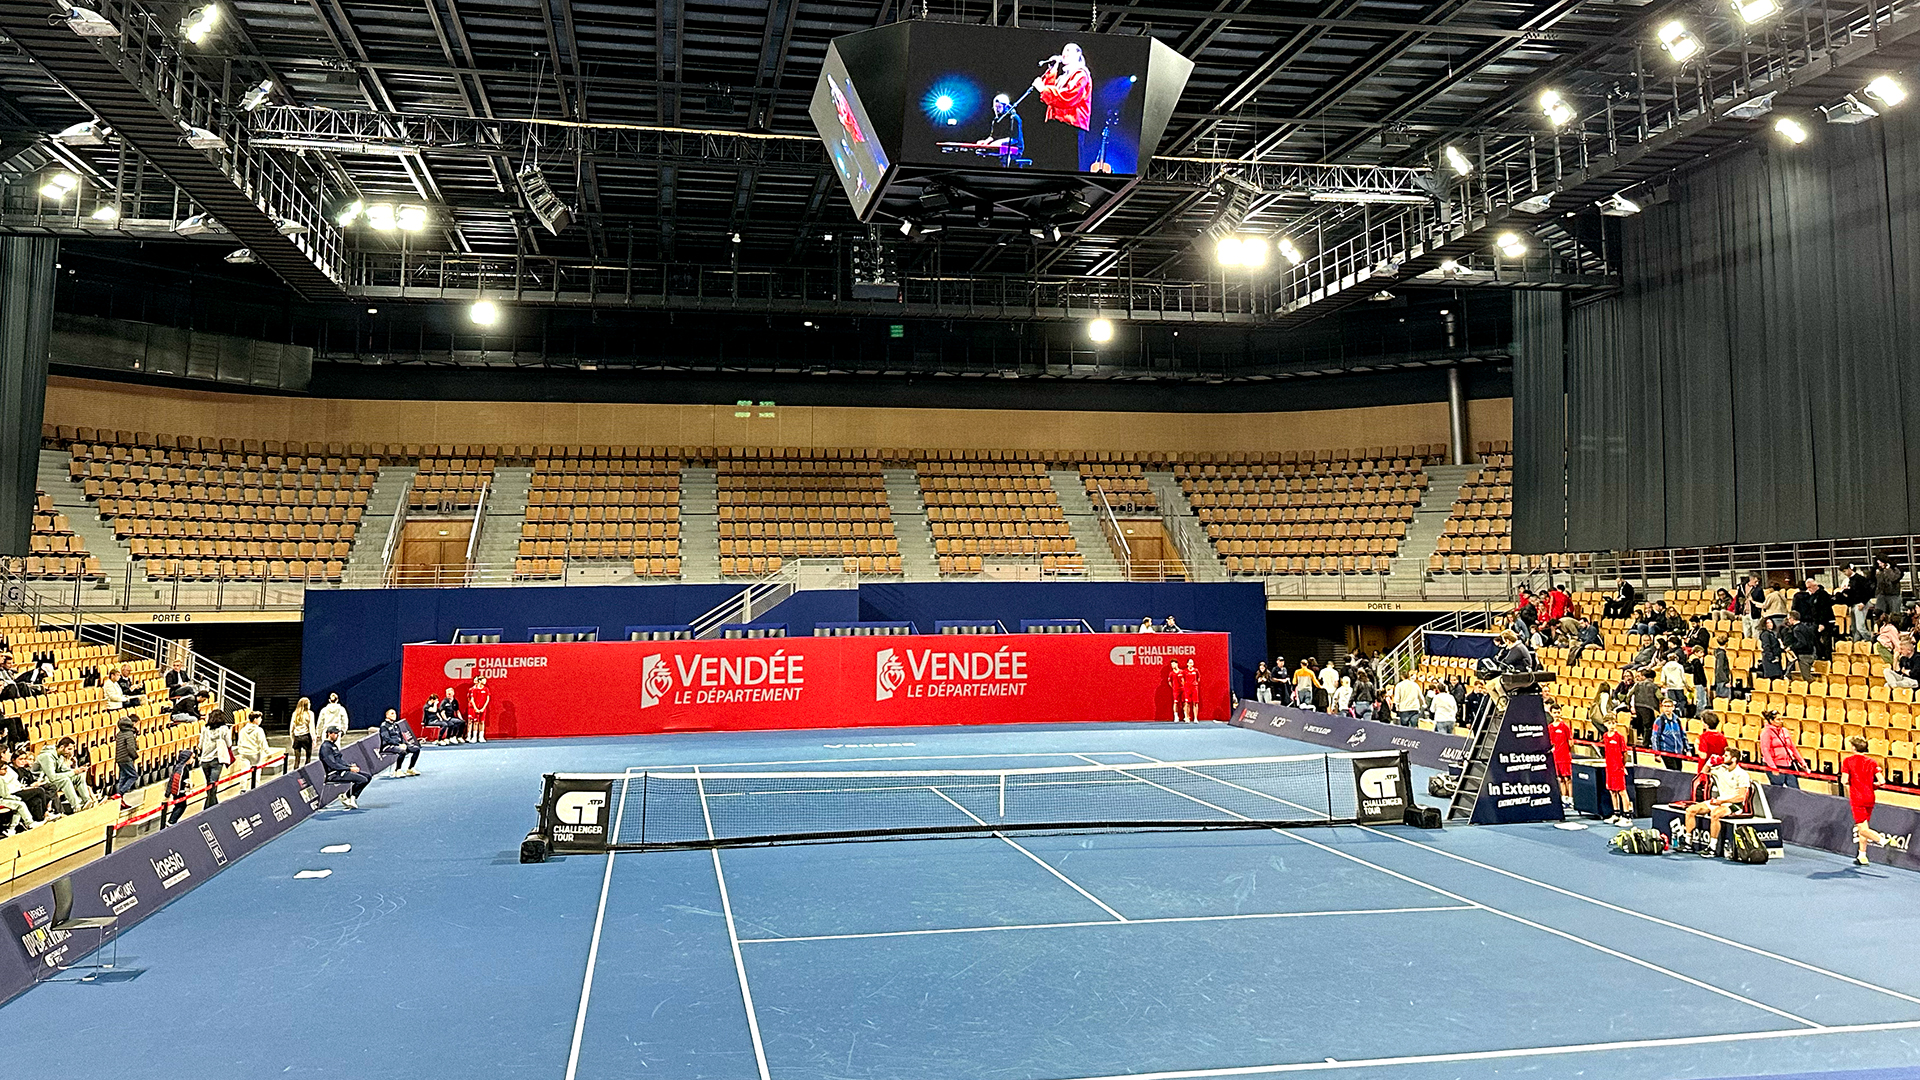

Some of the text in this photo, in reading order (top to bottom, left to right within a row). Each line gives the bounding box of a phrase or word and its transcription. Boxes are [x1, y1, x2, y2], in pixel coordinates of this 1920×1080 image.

[1127, 502, 1133, 513] B
[8, 586, 19, 601] G
[152, 613, 191, 622] PORTE G
[1138, 645, 1196, 655] CHALLENGER
[478, 656, 548, 668] CHALLENGER
[906, 645, 1028, 681] VENDÉE
[1138, 655, 1163, 666] TOUR
[478, 668, 508, 679] TOUR
[674, 649, 804, 687] VENDÉE
[907, 682, 1027, 698] LE DÉPARTEMENT
[674, 687, 804, 705] LE DÉPARTEMENT
[1391, 736, 1421, 750] MERCURE
[1499, 753, 1547, 763] In Extenso
[1488, 782, 1551, 796] In Extenso
[1362, 798, 1403, 808] CHALLENGER
[1363, 806, 1382, 816] TOUR
[553, 825, 603, 834] CHALLENGER
[553, 833, 575, 842] TOUR
[149, 848, 186, 880] koesio
